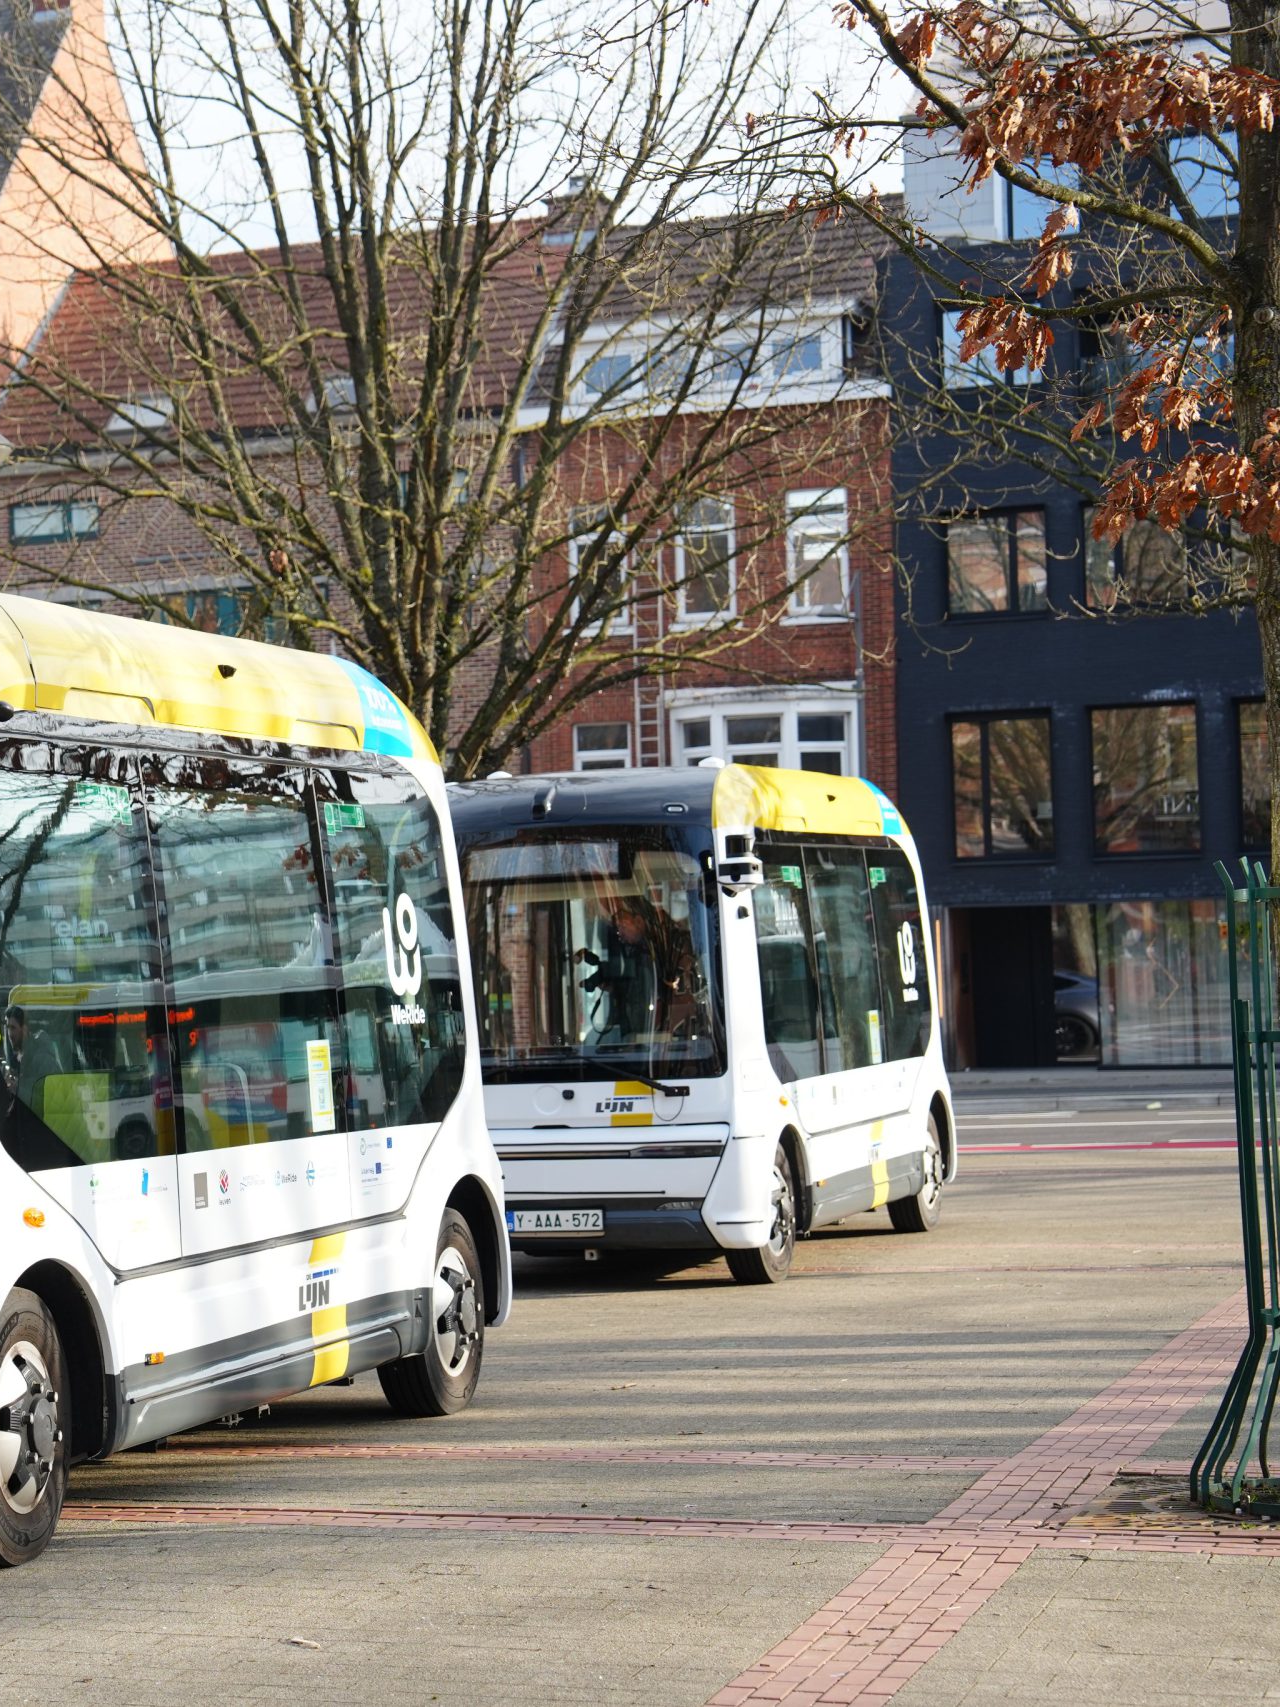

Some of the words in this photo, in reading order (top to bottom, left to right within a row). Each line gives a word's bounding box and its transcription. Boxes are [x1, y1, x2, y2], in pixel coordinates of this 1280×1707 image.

[390, 1004, 426, 1025] WeRide
[595, 1101, 634, 1113] LIJN
[516, 1213, 600, 1228] Y-AAA-572
[298, 1279, 330, 1311] LIJN
